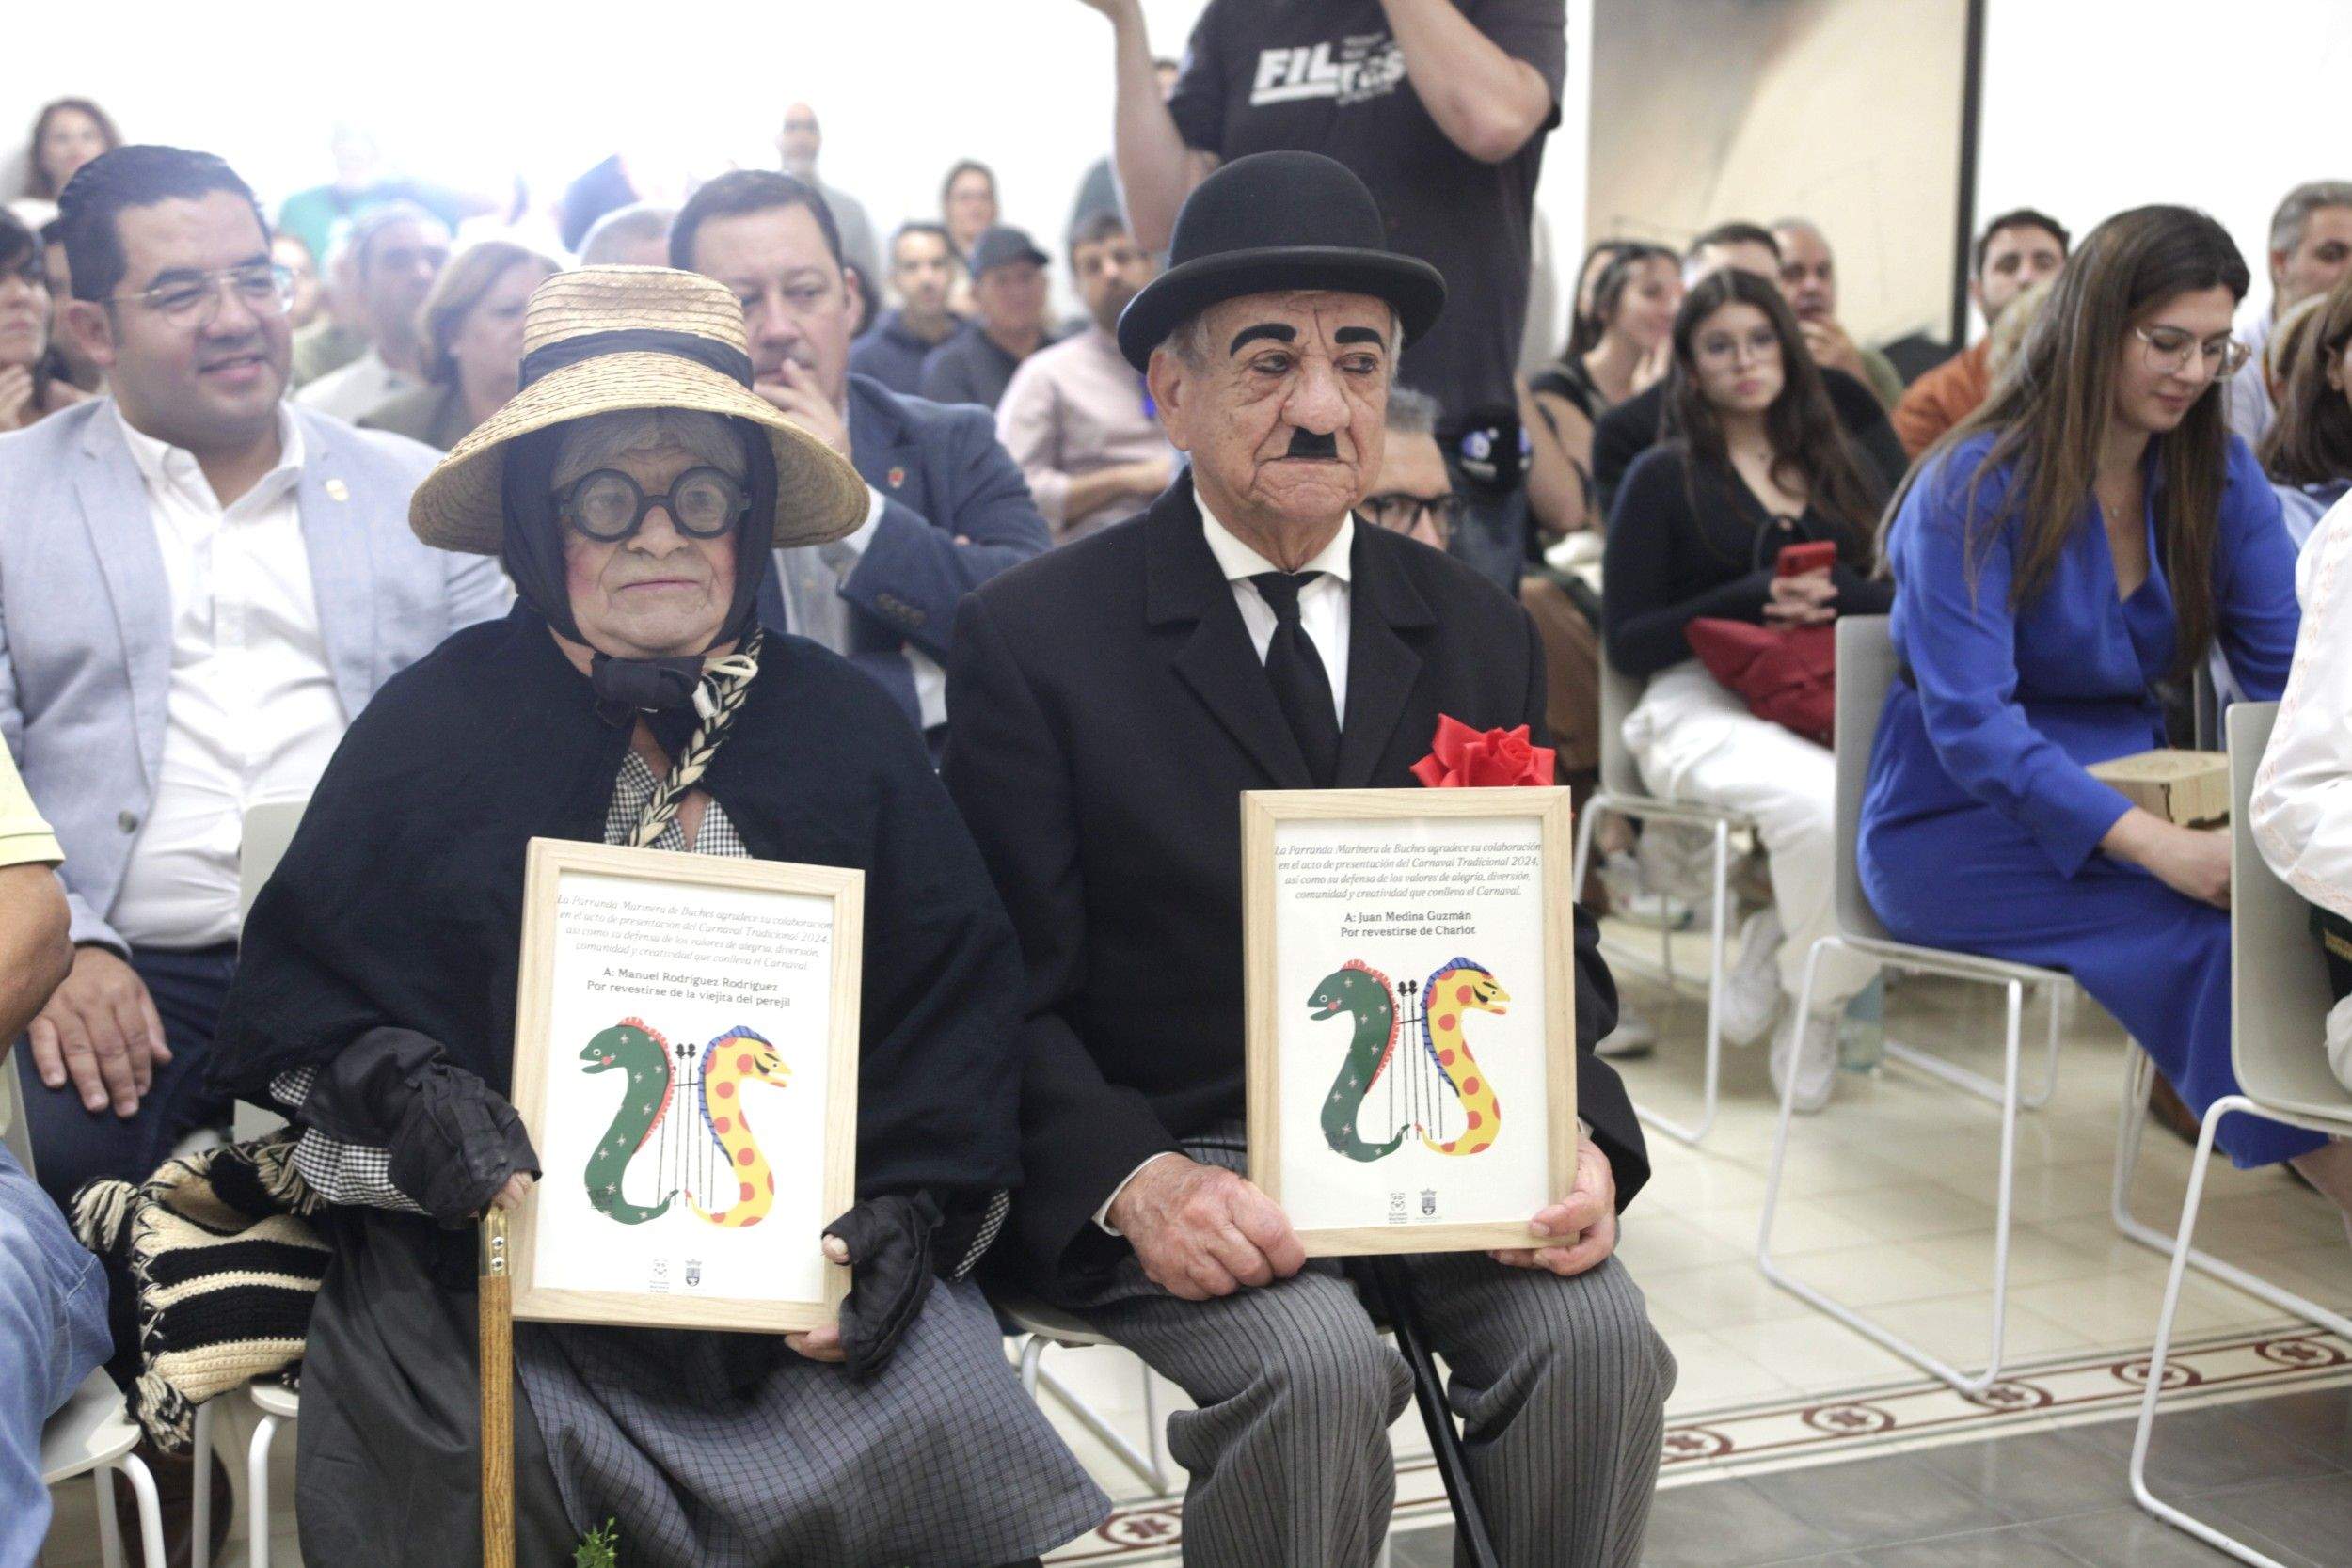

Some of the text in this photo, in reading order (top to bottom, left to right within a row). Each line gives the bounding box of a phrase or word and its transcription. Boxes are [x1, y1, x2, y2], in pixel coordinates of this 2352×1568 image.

[1275, 846, 1287, 855] La
[1289, 846, 1333, 855] Parranda
[1338, 845, 1378, 854] Marinera
[1381, 845, 1391, 853] de
[1393, 844, 1427, 853] Buches
[1428, 844, 1468, 855] agradece
[1483, 842, 1541, 852] colaboración
[1291, 861, 1300, 869] el
[1301, 861, 1321, 869] acto
[1335, 859, 1394, 871] presentación
[1396, 859, 1409, 867] del
[1412, 858, 1454, 867] Carnaval
[1457, 857, 1509, 867] Tradicional
[1341, 874, 1375, 886] defensa
[1377, 874, 1388, 882] de
[1390, 874, 1403, 882] los
[1406, 873, 1437, 881] valores
[1439, 873, 1449, 881] de
[1295, 890, 1347, 899] comunidad
[1347, 891, 1355, 900] y
[1357, 888, 1407, 897] creatividad
[1409, 890, 1425, 899] que
[1428, 887, 1465, 897] conlleva
[1467, 886, 1474, 895] el
[1344, 911, 1471, 923] A: Juan Medina Guzmán
[1341, 926, 1475, 936] Por revestirse de Charlot
[604, 967, 779, 991] A: Manuel Rodríguez Rodríguez
[587, 980, 790, 1008] Por revestirse de la viejita del perejil
